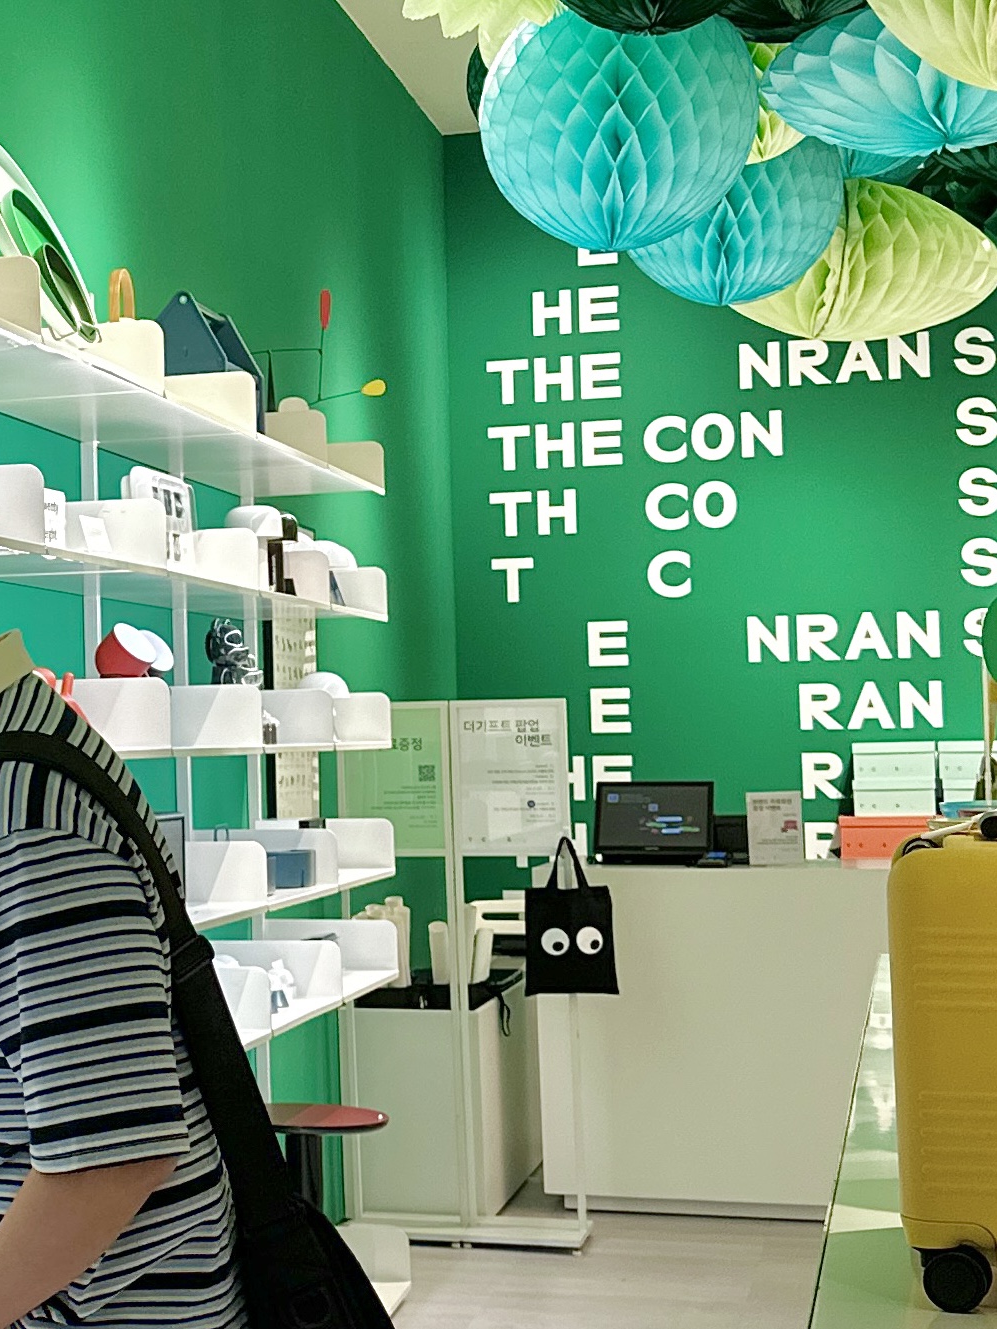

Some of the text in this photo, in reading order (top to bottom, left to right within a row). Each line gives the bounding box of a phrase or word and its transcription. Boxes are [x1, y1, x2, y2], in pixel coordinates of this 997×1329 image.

[532, 285, 620, 337] HE
[485, 326, 996, 405] THE NRAN S
[487, 396, 997, 471] THE CON S
[489, 467, 997, 537] TH CO S
[491, 537, 997, 603] T C S
[587, 620, 629, 667] E
[746, 609, 941, 663] NRAN
[463, 719, 539, 733] 더기프트 팝업
[590, 680, 944, 734] E RAN
[515, 734, 552, 747] 이벤트
[801, 752, 844, 800] R
